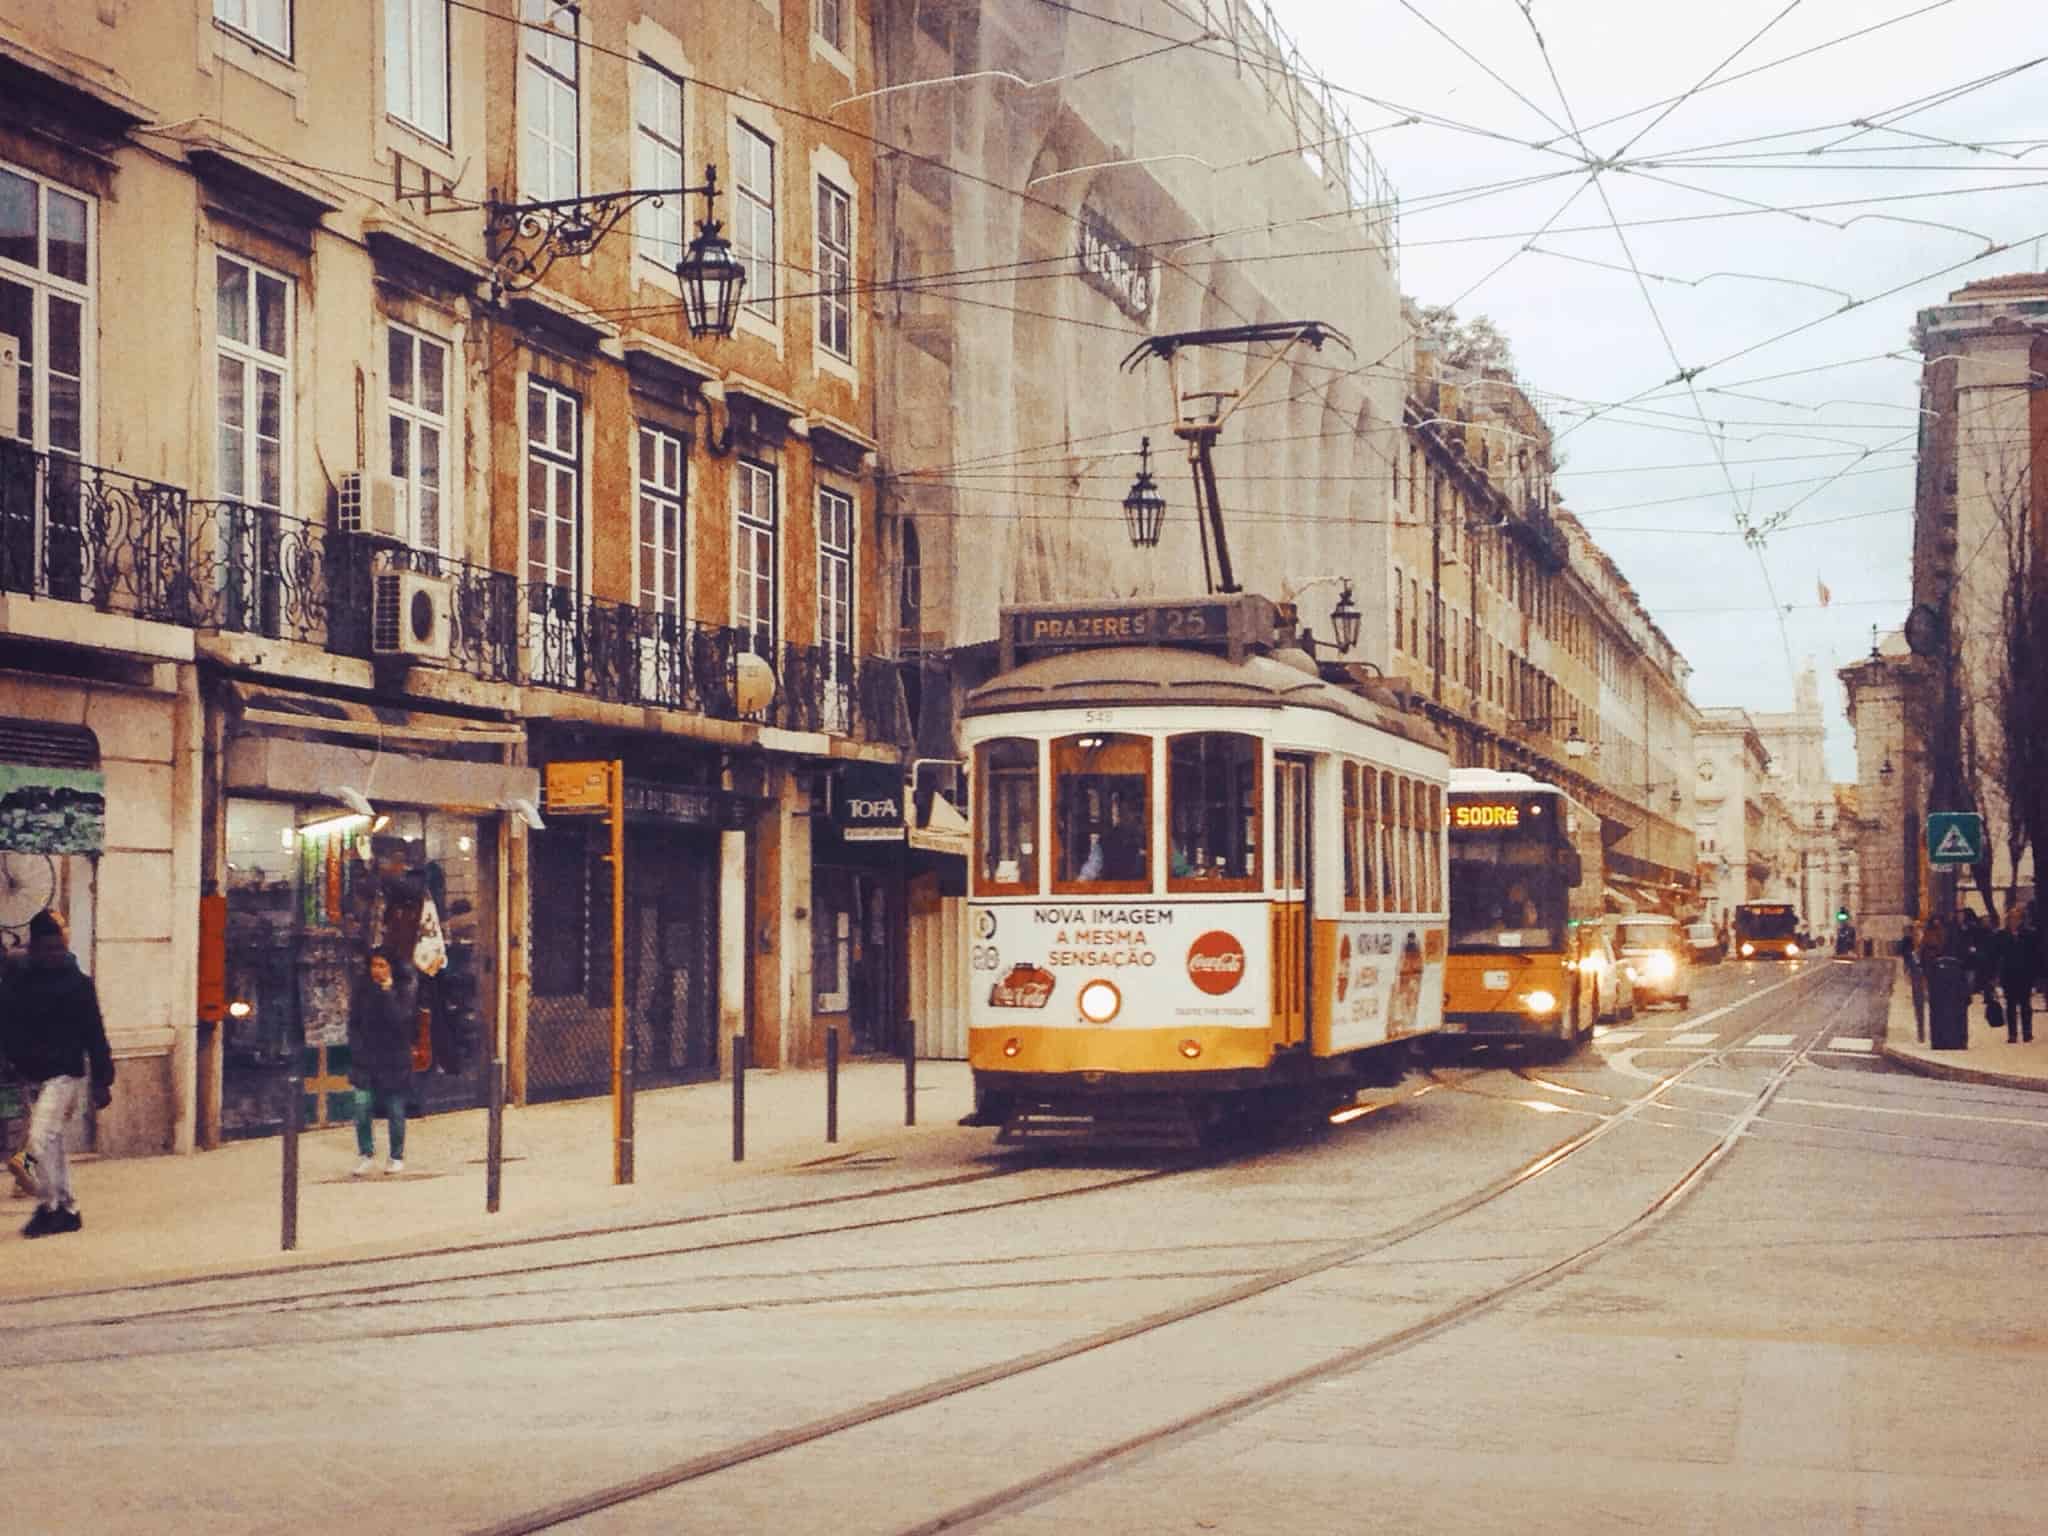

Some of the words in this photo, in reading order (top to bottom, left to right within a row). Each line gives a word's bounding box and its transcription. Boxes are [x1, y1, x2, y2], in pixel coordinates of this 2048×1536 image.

[1034, 613, 1146, 639] PRAZERES
[1167, 609, 1206, 636] 25
[848, 799, 899, 818] TOFA
[1034, 908, 1086, 924] NOVA
[1093, 908, 1173, 924] IMAGEM
[1056, 930, 1068, 945] A
[1075, 930, 1147, 945] MESMA
[1049, 948, 1157, 968] SENSAÇÃO
